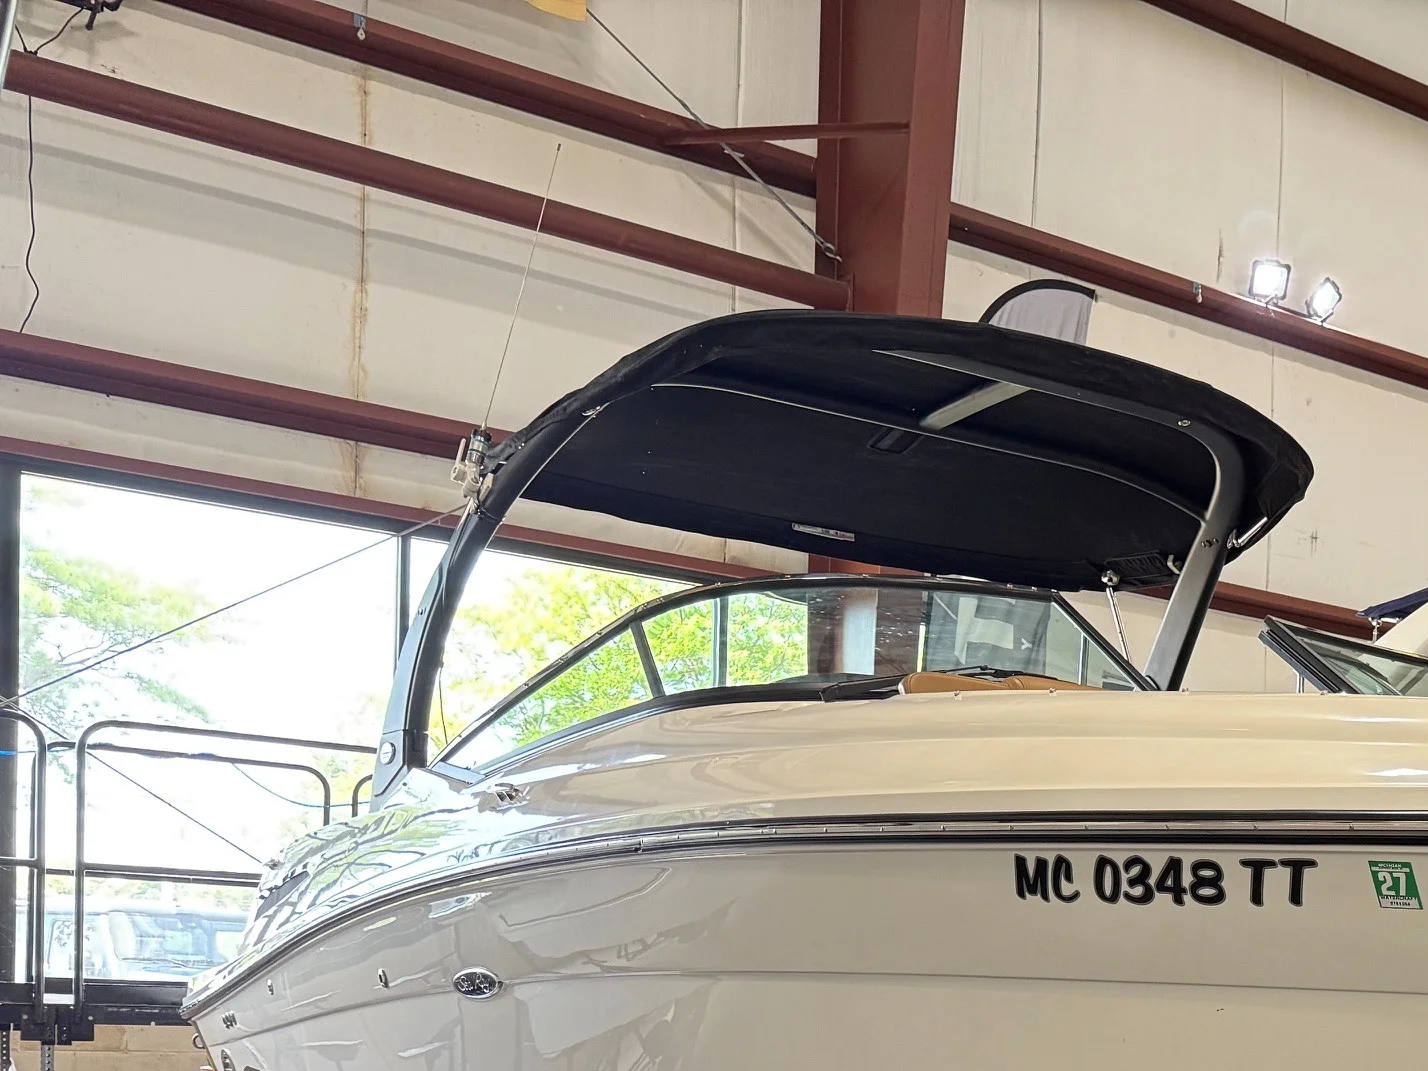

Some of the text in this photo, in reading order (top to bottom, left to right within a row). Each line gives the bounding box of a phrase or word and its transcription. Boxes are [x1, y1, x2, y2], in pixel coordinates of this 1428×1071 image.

[1013, 853, 1318, 907] MC 0348 TT
[1377, 871, 1406, 896] 27
